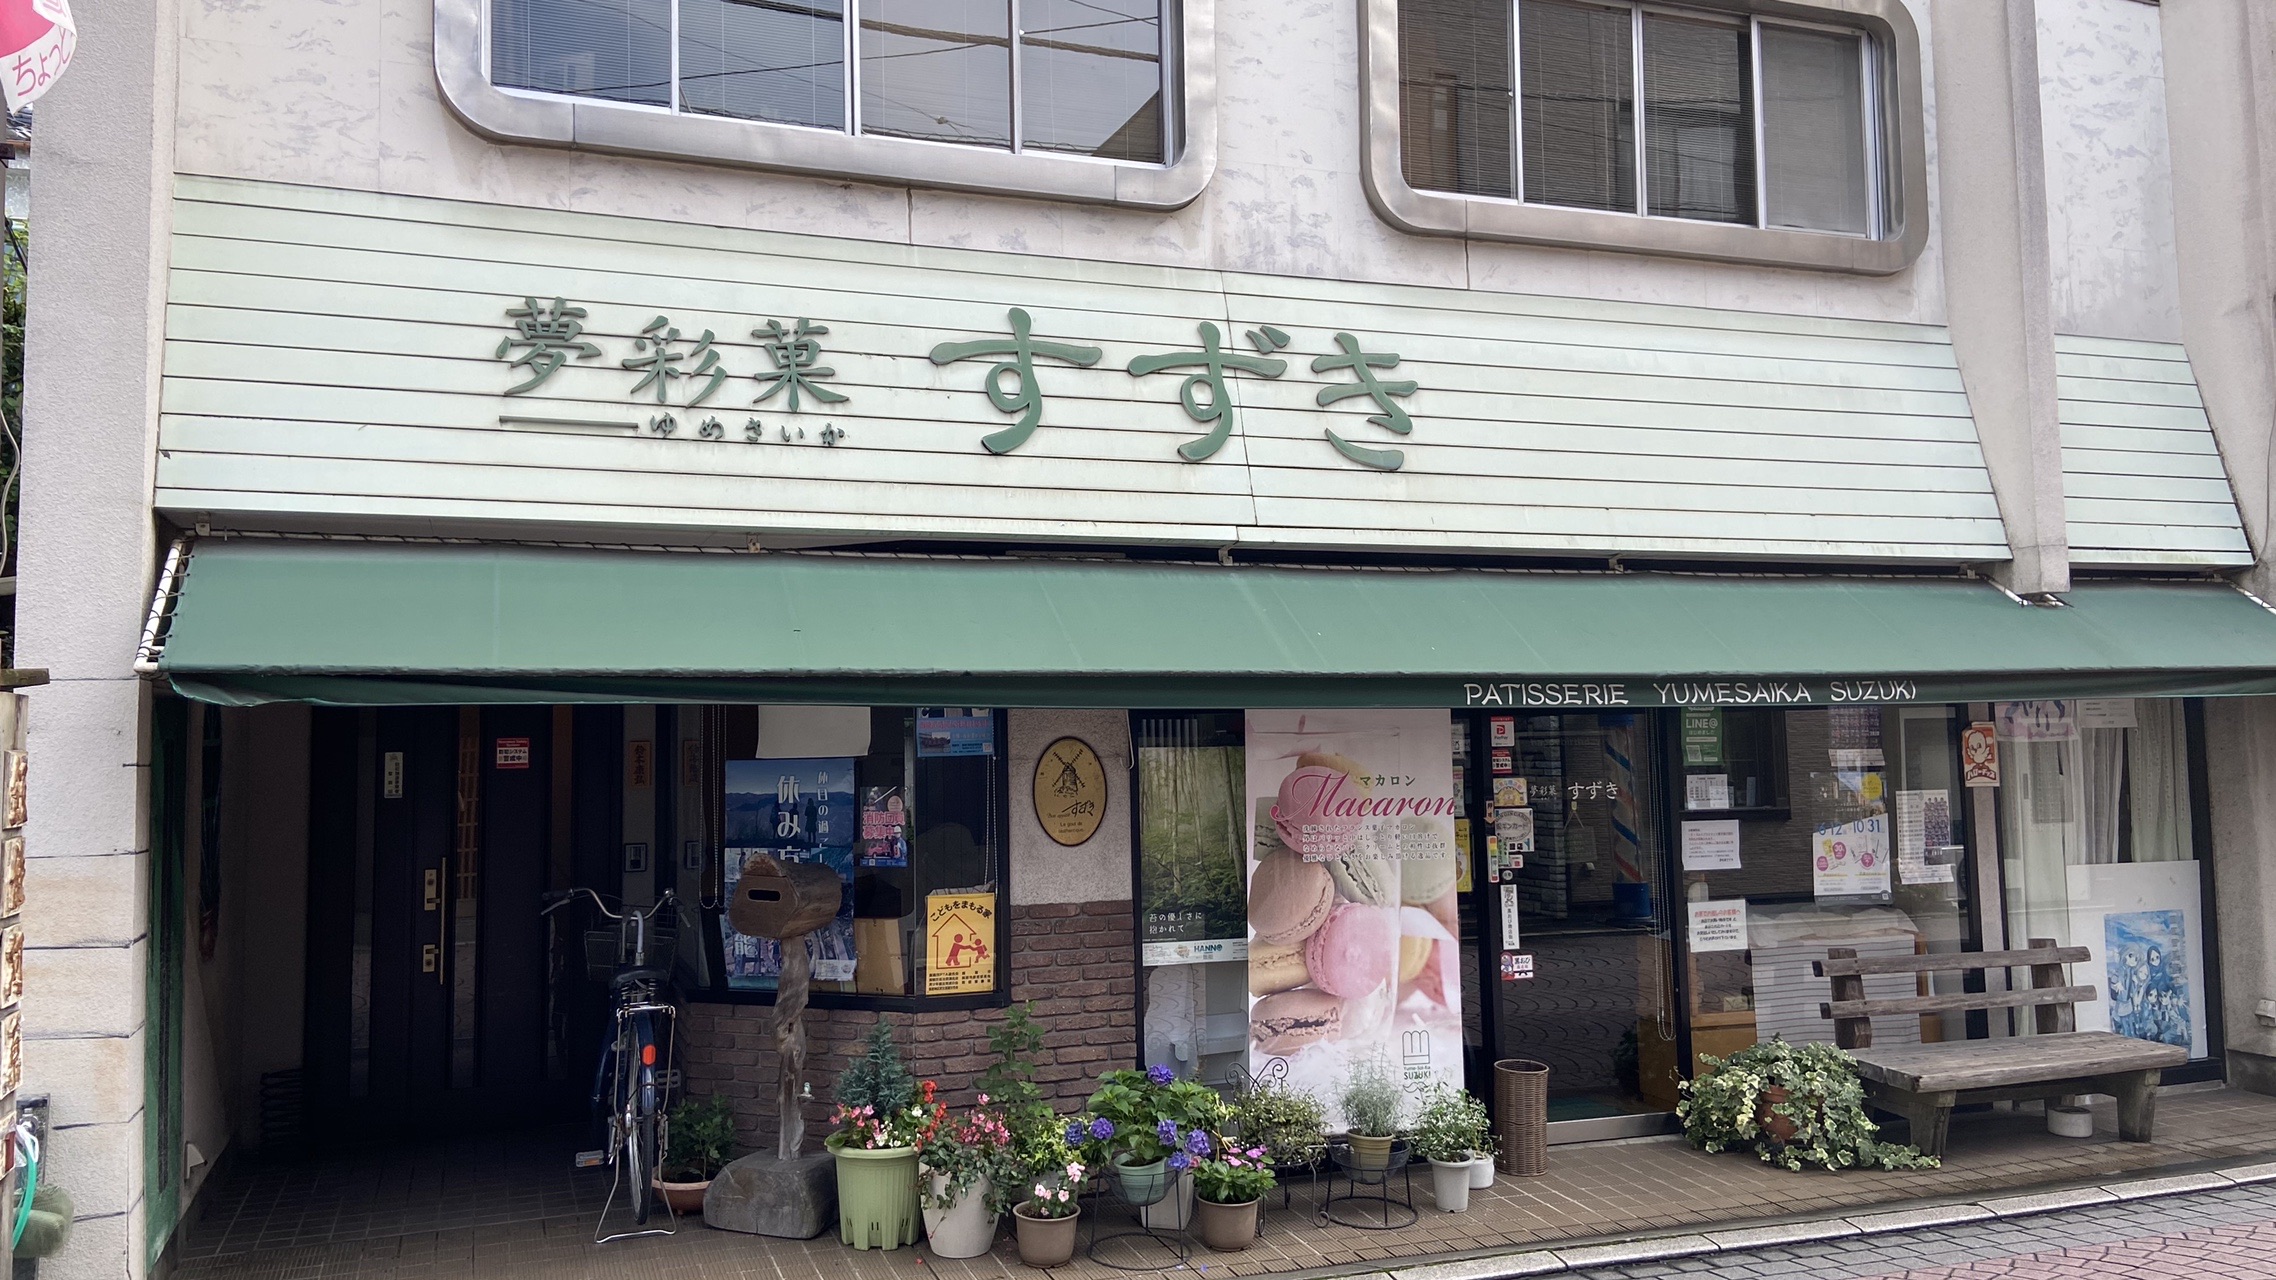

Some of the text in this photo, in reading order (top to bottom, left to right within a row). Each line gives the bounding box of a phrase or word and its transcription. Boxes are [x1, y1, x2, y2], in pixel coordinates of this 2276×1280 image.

[497, 296, 1419, 472] 夢彩菓 すずき
[649, 412, 849, 447] ゆめさいか
[1463, 681, 1918, 706] PATISSERIE YUMESAIKA SUZUKI
[1686, 717, 1719, 729] LINE@
[1360, 774, 1416, 786] マカロン
[1270, 769, 1456, 823] Macaron
[1529, 784, 1558, 798] 夢彩菓
[1567, 781, 1619, 800] すずき
[1867, 819, 1881, 833] 31
[930, 900, 993, 922] こどもをまもる家
[1193, 943, 1224, 954] HANNO
[1403, 1071, 1431, 1081] SUZUKI
